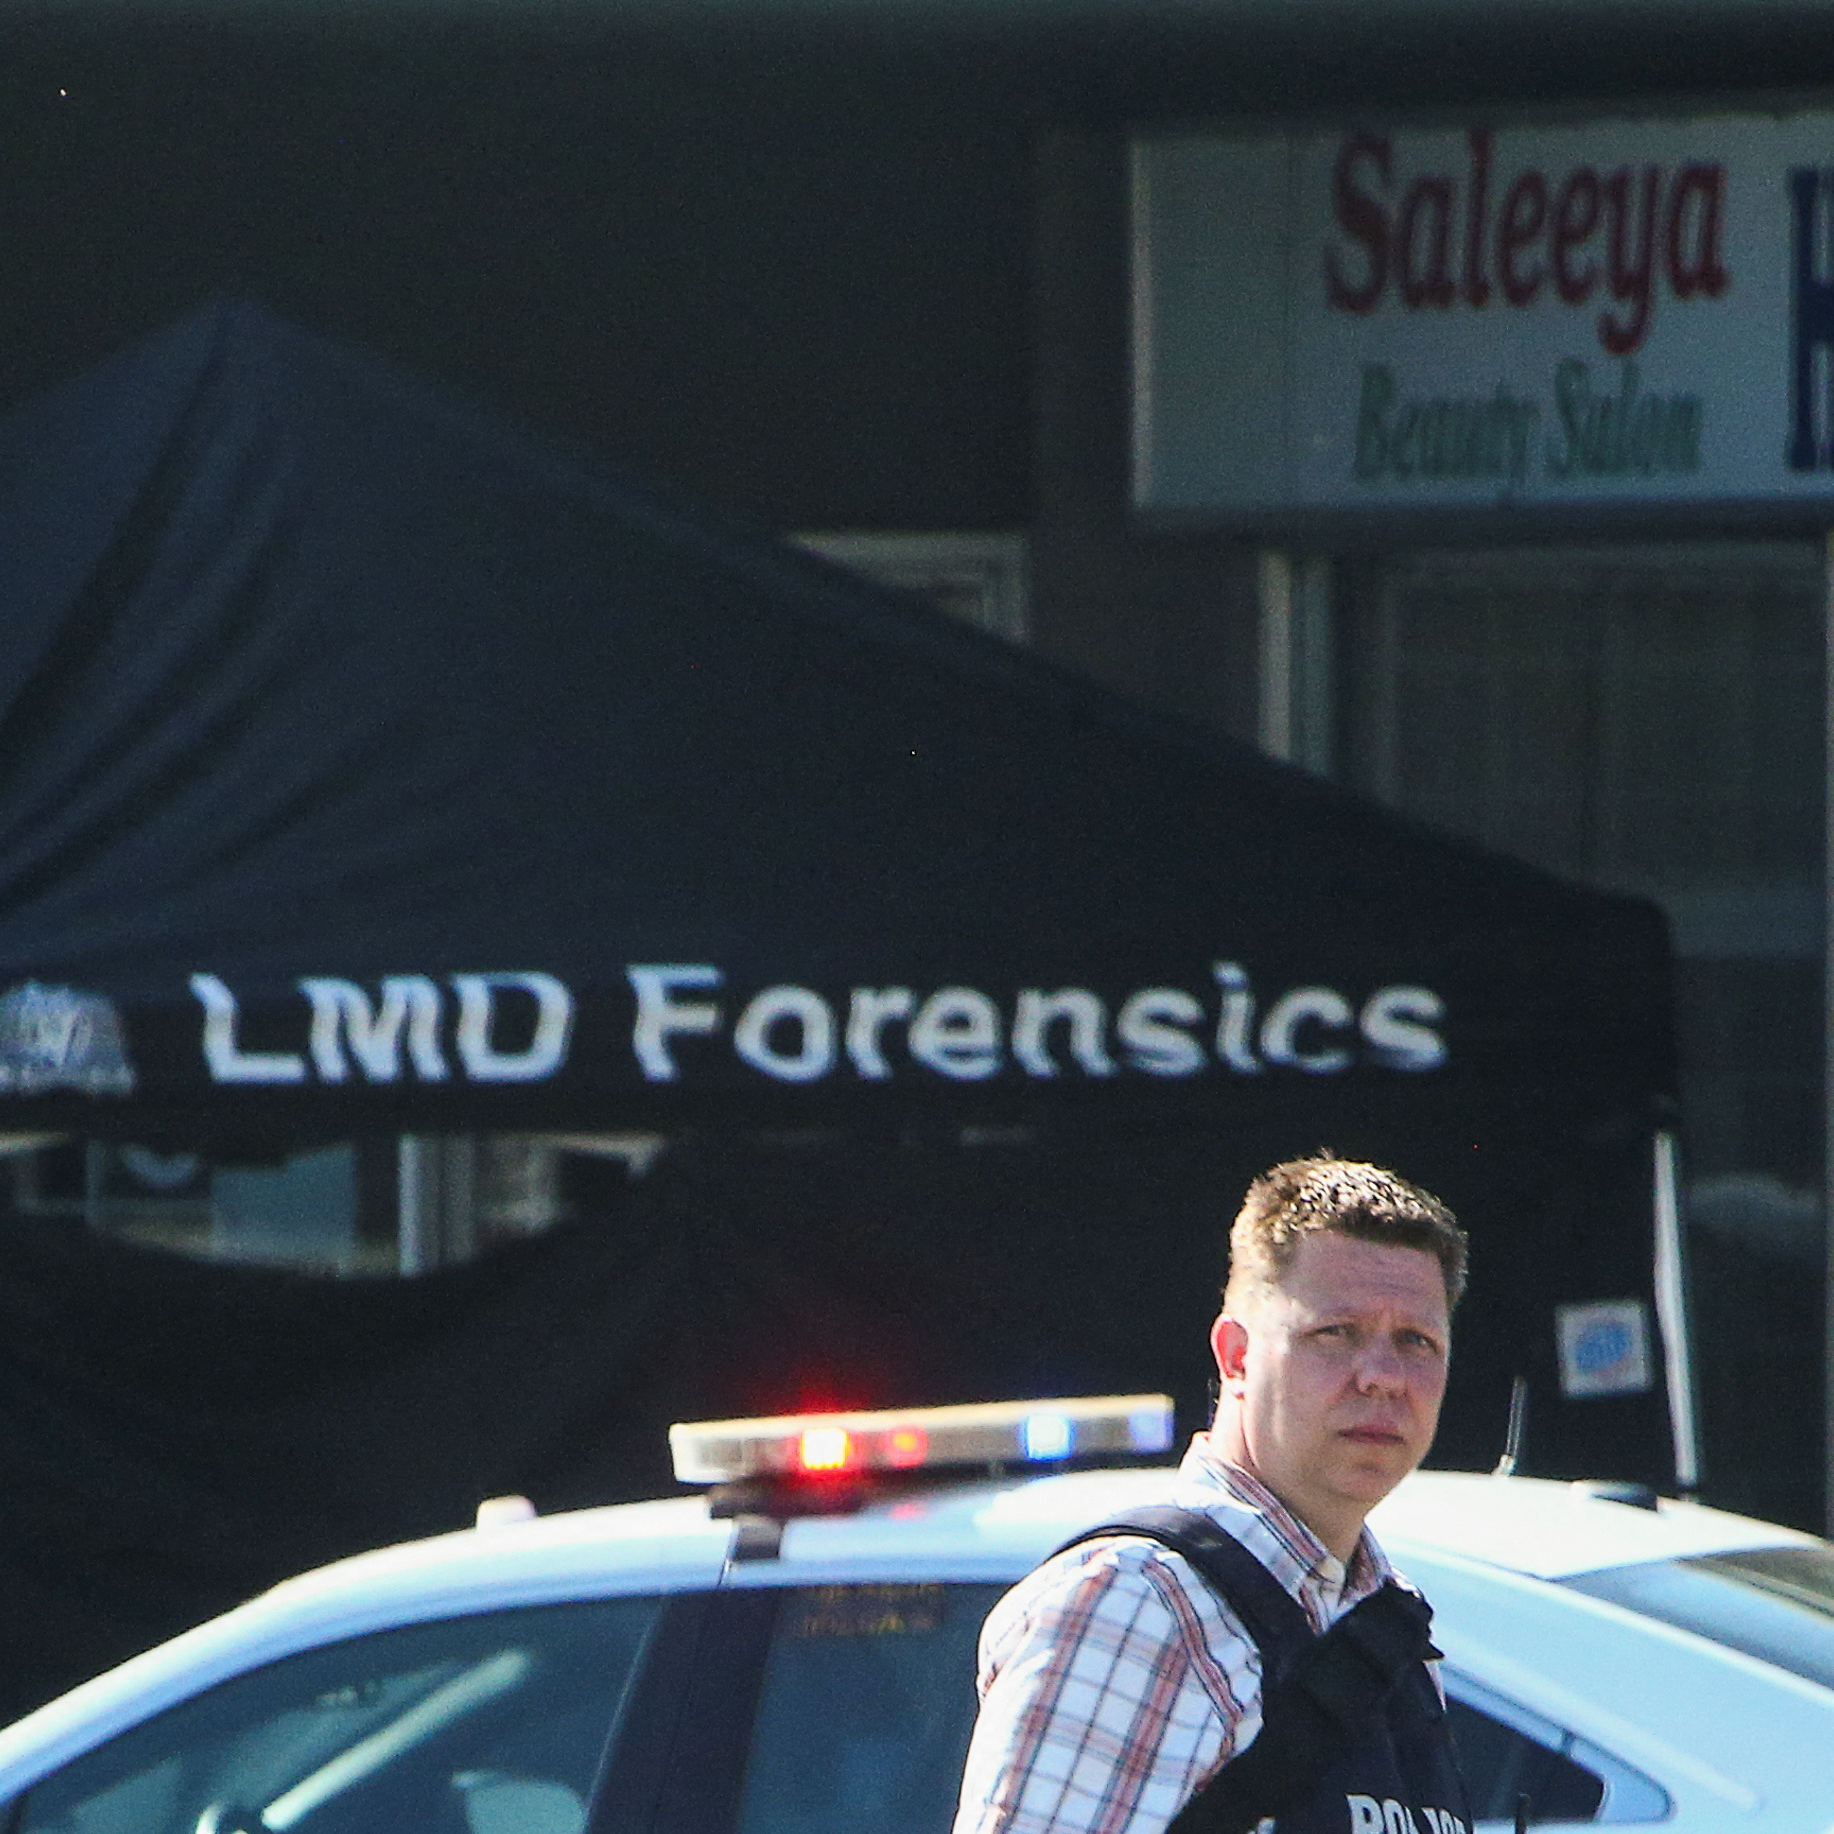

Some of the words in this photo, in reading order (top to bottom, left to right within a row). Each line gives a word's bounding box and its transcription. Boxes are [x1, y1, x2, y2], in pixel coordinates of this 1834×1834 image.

[1324, 130, 1730, 355] Saleeya
[1357, 362, 1541, 506] Beauty
[1545, 358, 1703, 480] Salon
[192, 972, 572, 1084] LMD
[627, 962, 1448, 1081] Forensics
